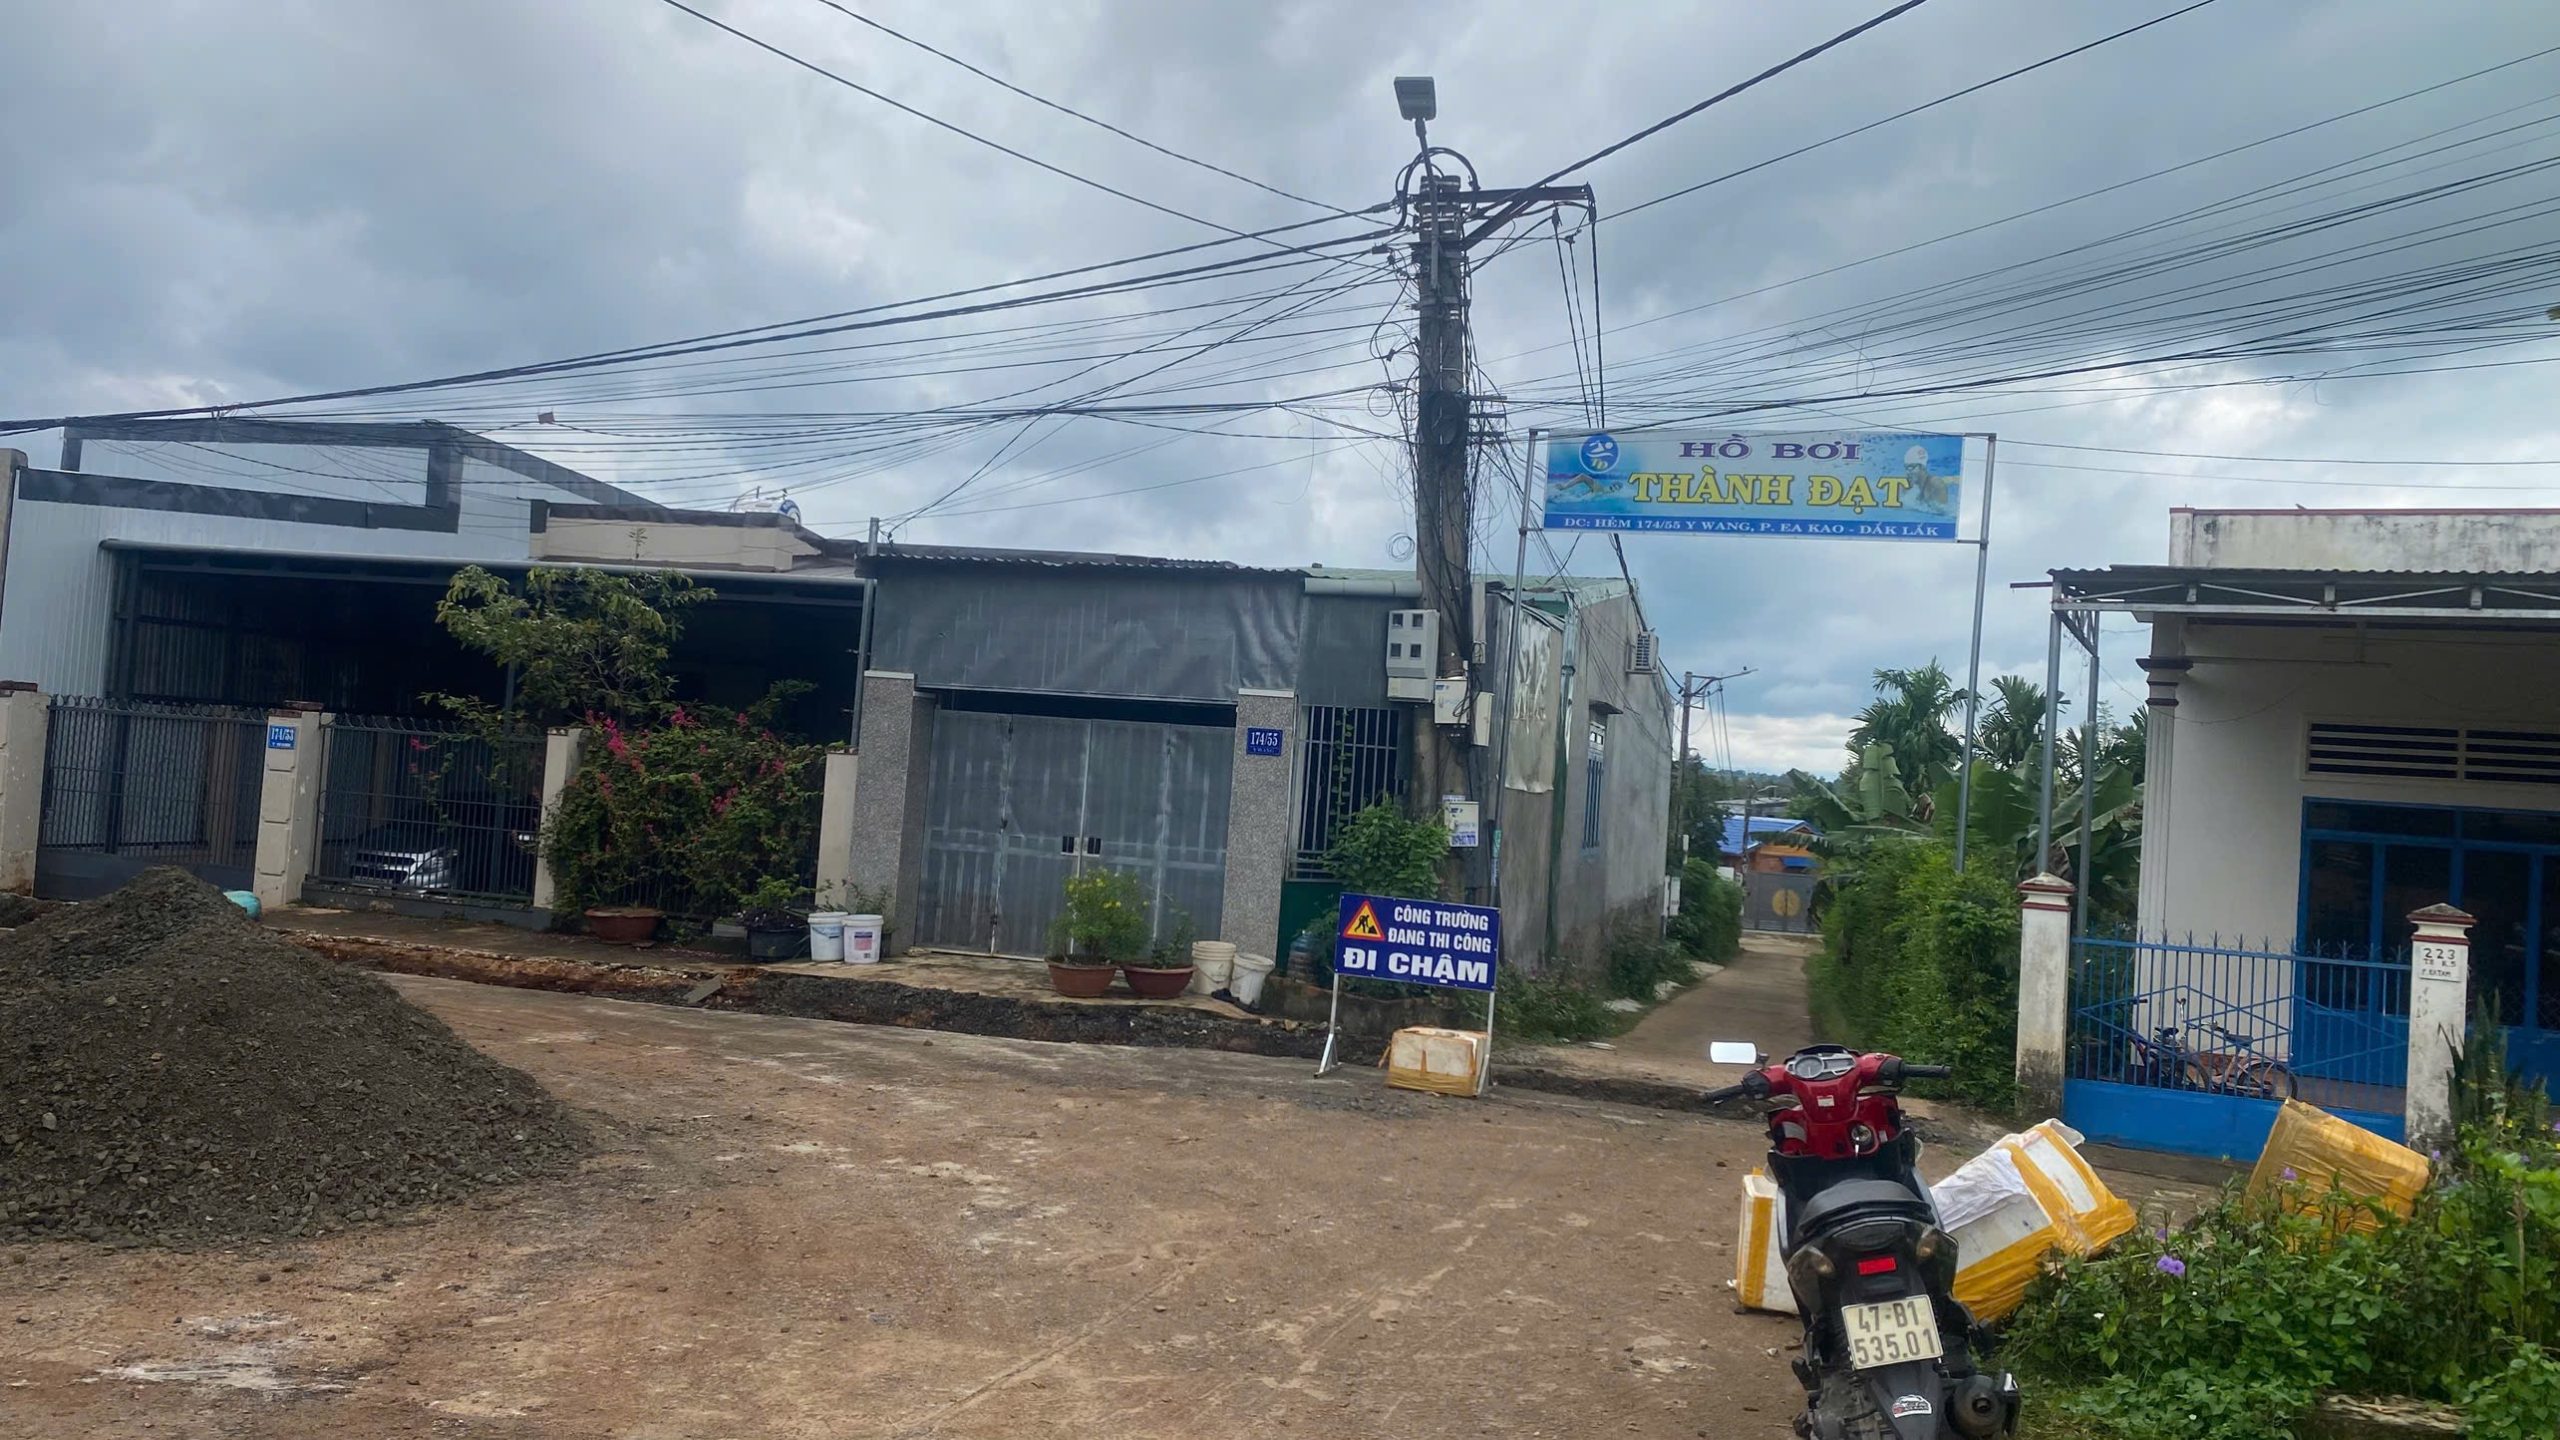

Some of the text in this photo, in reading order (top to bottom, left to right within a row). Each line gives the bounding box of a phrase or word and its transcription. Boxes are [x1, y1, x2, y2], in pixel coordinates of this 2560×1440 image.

[1679, 433, 1861, 460] HỒ BƠI
[1627, 464, 1912, 514] THÀNH ĐẠT
[1638, 519, 1681, 530] 174/55
[1686, 520, 1697, 530] Y
[1702, 521, 1755, 532] WANG,
[1760, 522, 1775, 532] P.
[1780, 523, 1802, 533] EA
[1808, 524, 1845, 534] KAO
[1250, 731, 1279, 747] 174/55
[1394, 904, 1489, 931] CÔNG TRƯỜNG
[1388, 927, 1491, 953] ĐANG THI CÔNG
[2423, 947, 2456, 960] 223
[1343, 947, 1489, 984] ĐI CHẬM
[1858, 1300, 1920, 1333] 47-B1
[1854, 1328, 1936, 1365] 535.01
